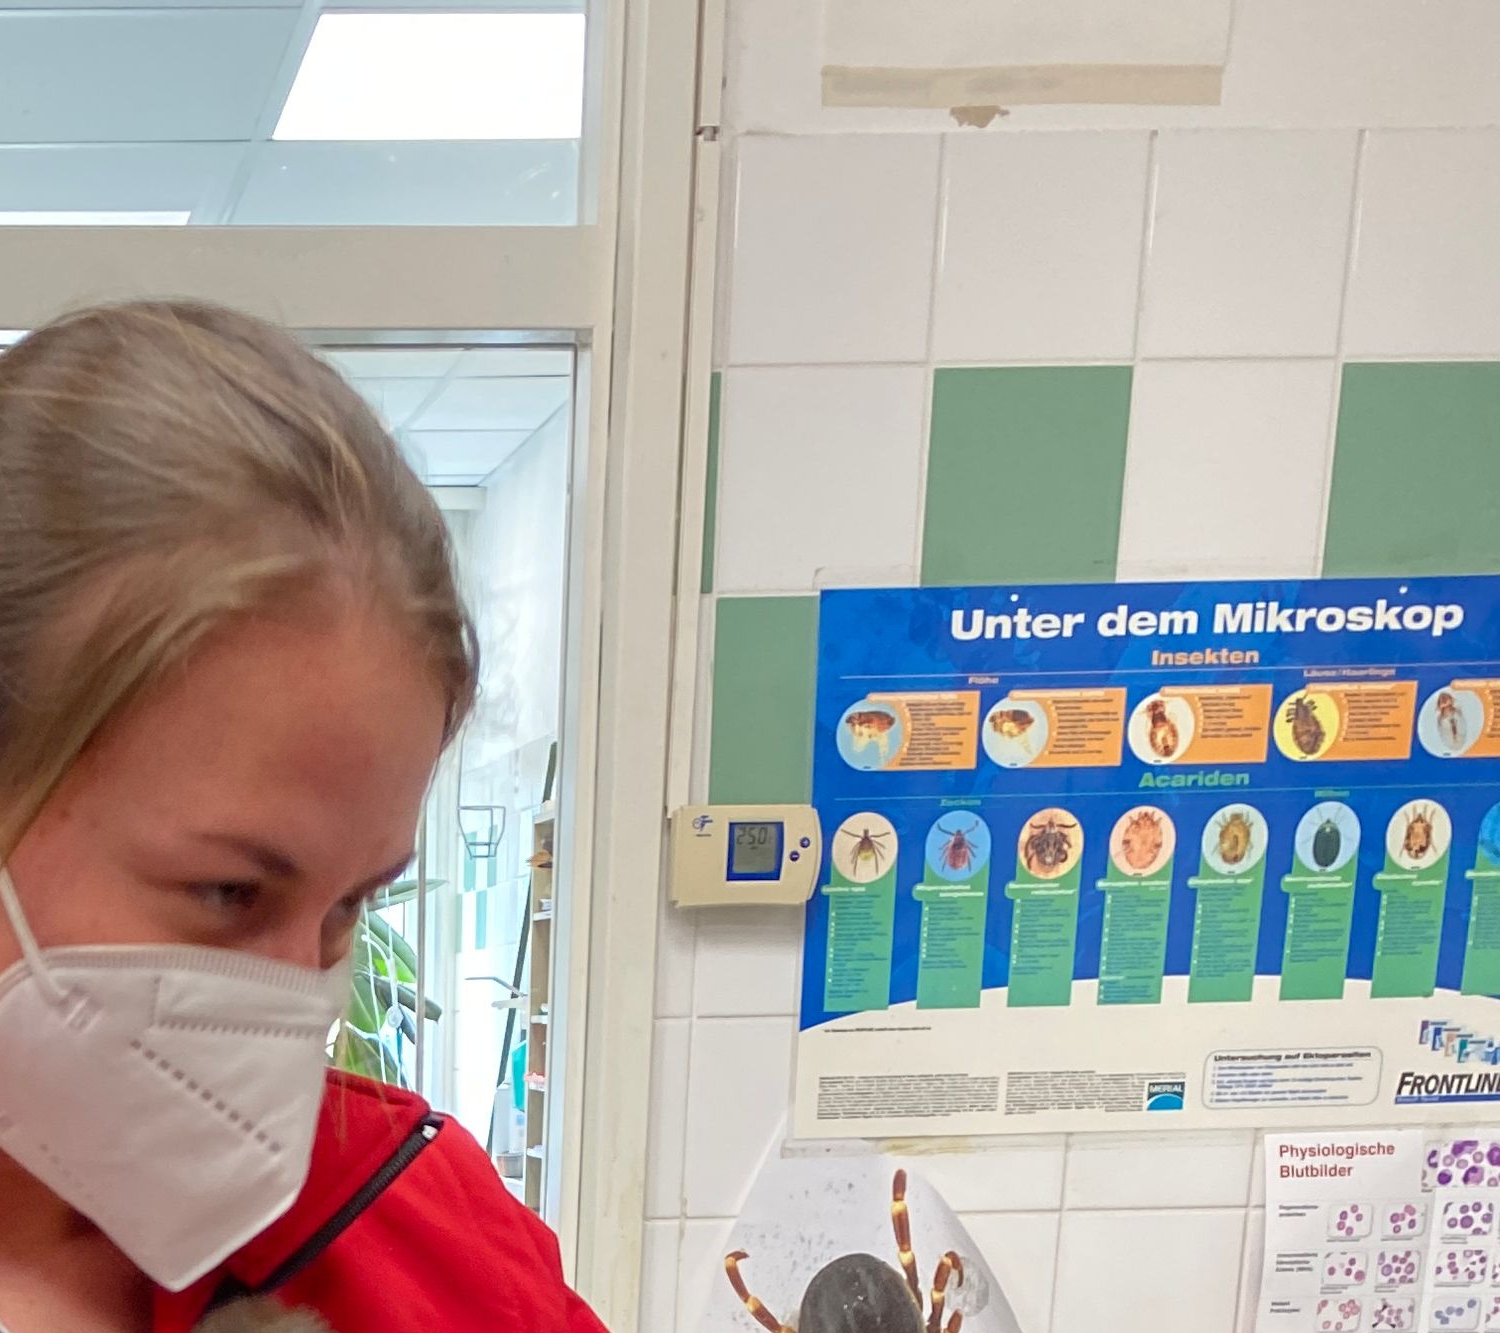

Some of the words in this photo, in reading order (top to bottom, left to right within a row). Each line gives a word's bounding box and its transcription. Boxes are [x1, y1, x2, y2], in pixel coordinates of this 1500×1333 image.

[951, 607, 1085, 640] Unter
[1097, 604, 1199, 637] dem
[1213, 598, 1464, 637] Mikroskop
[1152, 648, 1260, 666] Insekten
[1139, 770, 1250, 788] Acariden
[1150, 1084, 1183, 1093] MERIAL
[1279, 1142, 1396, 1160] Physiologische
[1280, 1164, 1354, 1179] Blutbilder
